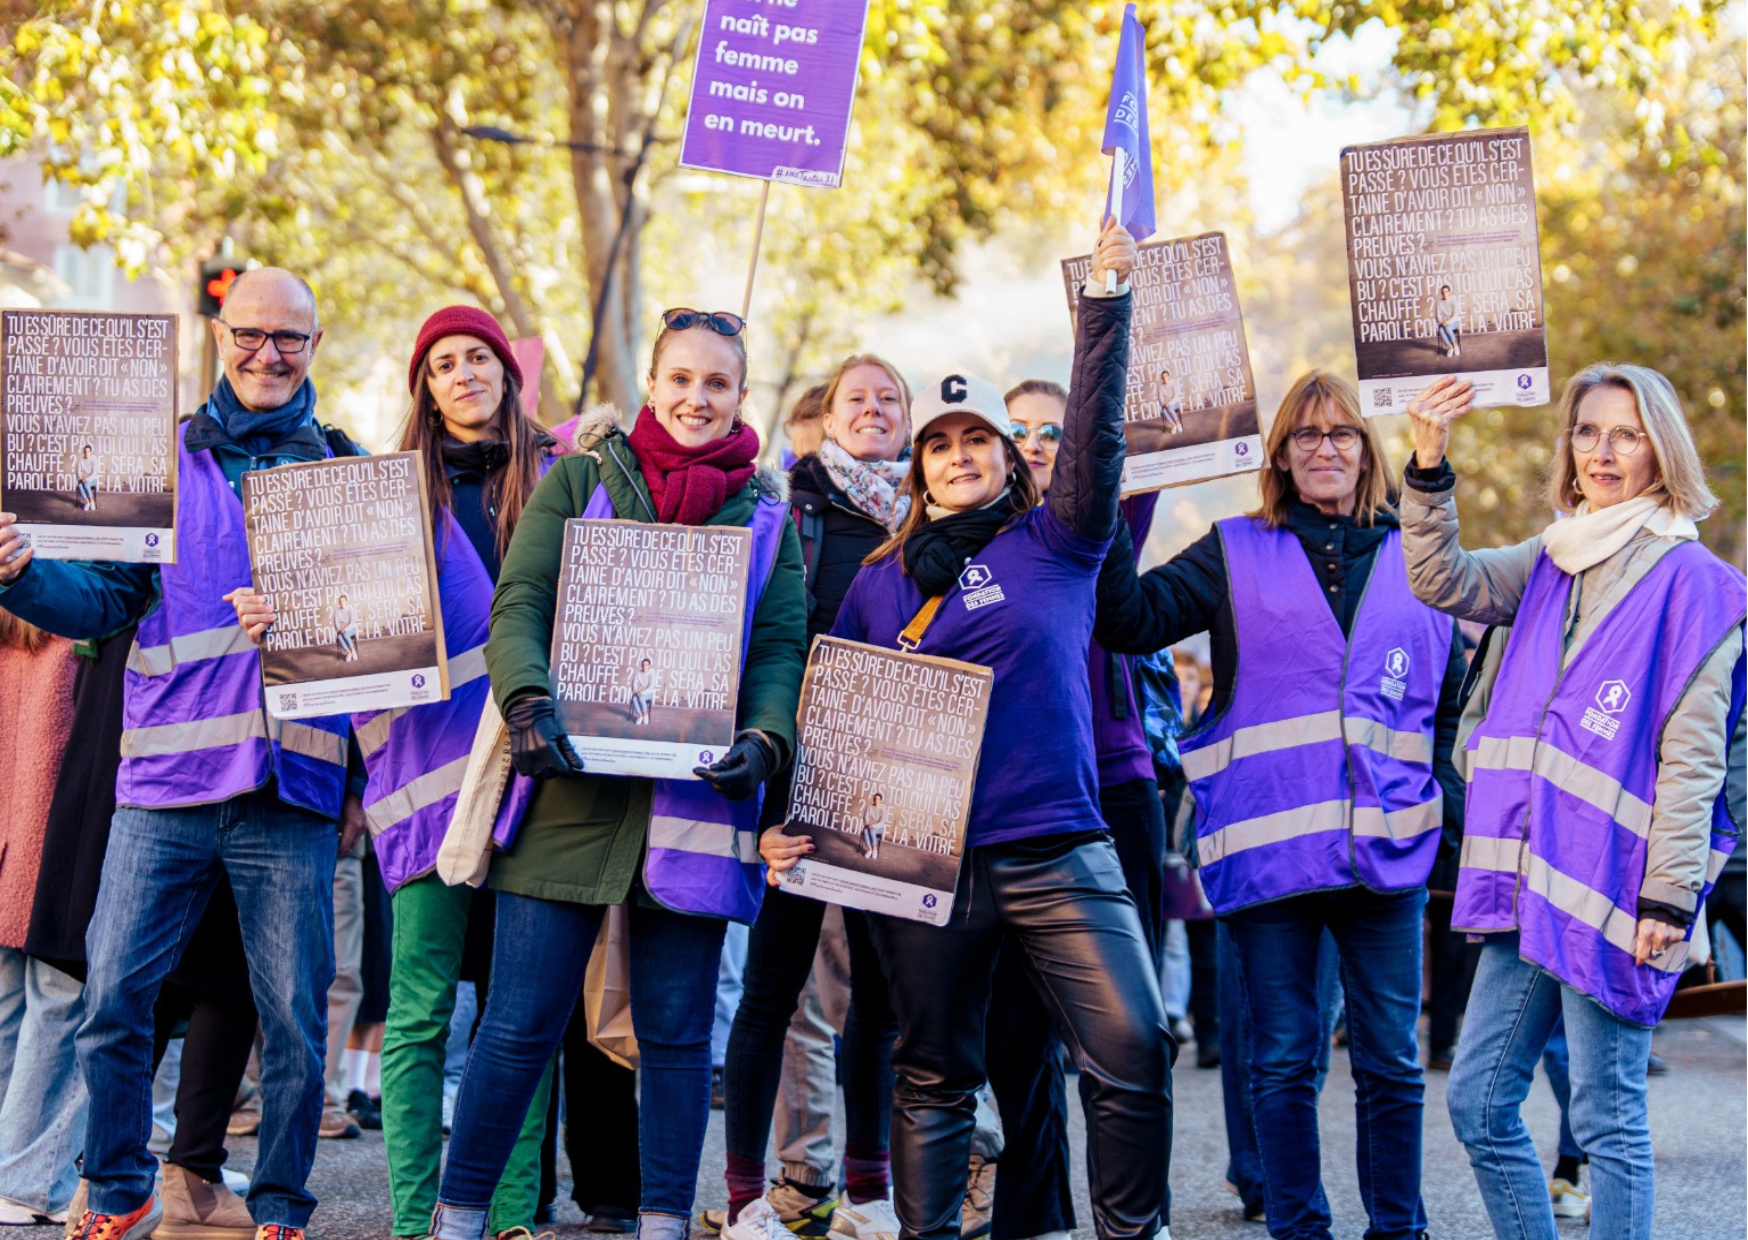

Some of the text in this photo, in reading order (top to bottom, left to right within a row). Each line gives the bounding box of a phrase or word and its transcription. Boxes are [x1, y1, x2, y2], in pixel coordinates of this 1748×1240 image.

[720, 14, 818, 45] naît pas
[715, 41, 799, 74] femme
[710, 80, 805, 110] mais on
[704, 113, 821, 146] en meurt.
[1346, 138, 1523, 172] TU ES SÛRE DE CE QU'IL S'EST
[1348, 168, 1395, 194] PASSÉ
[1409, 166, 1449, 189] VOUS
[1452, 160, 1487, 185] ÊTES
[1490, 161, 1525, 182] CER-
[1351, 210, 1442, 237] CLAIREMENT
[1456, 207, 1475, 228] TU
[1479, 206, 1497, 227] AS
[1500, 203, 1528, 225] DES
[1068, 261, 1085, 280] TU
[1147, 247, 1163, 266] CE
[1162, 242, 1193, 266] QU'IL
[1191, 236, 1221, 259] S'EST
[1161, 258, 1192, 283] ÊTES
[1194, 257, 1225, 277] CER-
[1353, 246, 1530, 279] VOUS N'AVIEZ PAS UN PEU
[1162, 281, 1181, 302] DIT
[1191, 275, 1219, 296] NON
[1168, 292, 1231, 320] TU AS DES
[7, 314, 169, 339] TU ES SÛRE DE CE QU'IL S'EST
[8, 333, 49, 355] PASSÉ
[63, 337, 99, 356] VOUS
[102, 335, 134, 357] ÊTES
[136, 339, 168, 358] CER-
[1166, 329, 1237, 358] PAS UN PEU
[7, 375, 90, 395] CLAIREMENT
[103, 377, 119, 396] TU
[122, 378, 139, 397] AS
[143, 379, 167, 397] DES
[941, 374, 967, 404] C
[6, 413, 166, 436] VOUS N'AVIEZ PAS UN PEU
[247, 457, 409, 495] TU ES SÛRE DE CE QU'IL S'EST
[250, 489, 294, 515] PASSÉ
[306, 486, 343, 508] VOUS
[345, 478, 377, 503] ÊTES
[380, 478, 411, 499] CER-
[254, 526, 337, 554] CLAIREMENT
[350, 523, 367, 542] TU
[371, 520, 388, 540] AS
[390, 517, 416, 538] DES
[573, 525, 743, 555] TU ES SÛRE DE CE QU'IL S'EST
[570, 542, 616, 566] PASSÉ
[631, 549, 668, 569] VOUS
[671, 549, 706, 572] ÊTES
[707, 554, 740, 574] CER-
[258, 556, 419, 593] VOUS N'AVIEZ PAS UN PEU
[566, 584, 656, 608] CLAIREMENT
[669, 591, 686, 610] TU
[688, 592, 707, 611] AS
[710, 594, 737, 613] DES
[562, 623, 733, 652] VOUS N'AVIEZ PAS UN PEU
[818, 644, 986, 699] TU ES SÛRE DE CE QU'IL S'EST
[813, 663, 858, 692] PASSÉ
[872, 677, 909, 703] VOUS
[911, 683, 947, 711] ÊTES
[947, 694, 981, 718] CER-
[806, 705, 894, 741] CLAIREMENT
[906, 727, 924, 748] TU
[924, 732, 944, 753] AS
[945, 736, 973, 759] DES
[1584, 709, 1620, 730] FONDATION
[801, 744, 835, 769] VOUS
[837, 753, 887, 781] N'AVIEZ
[888, 764, 914, 787] PAS
[917, 771, 936, 791] UN
[939, 776, 966, 798] PEU
